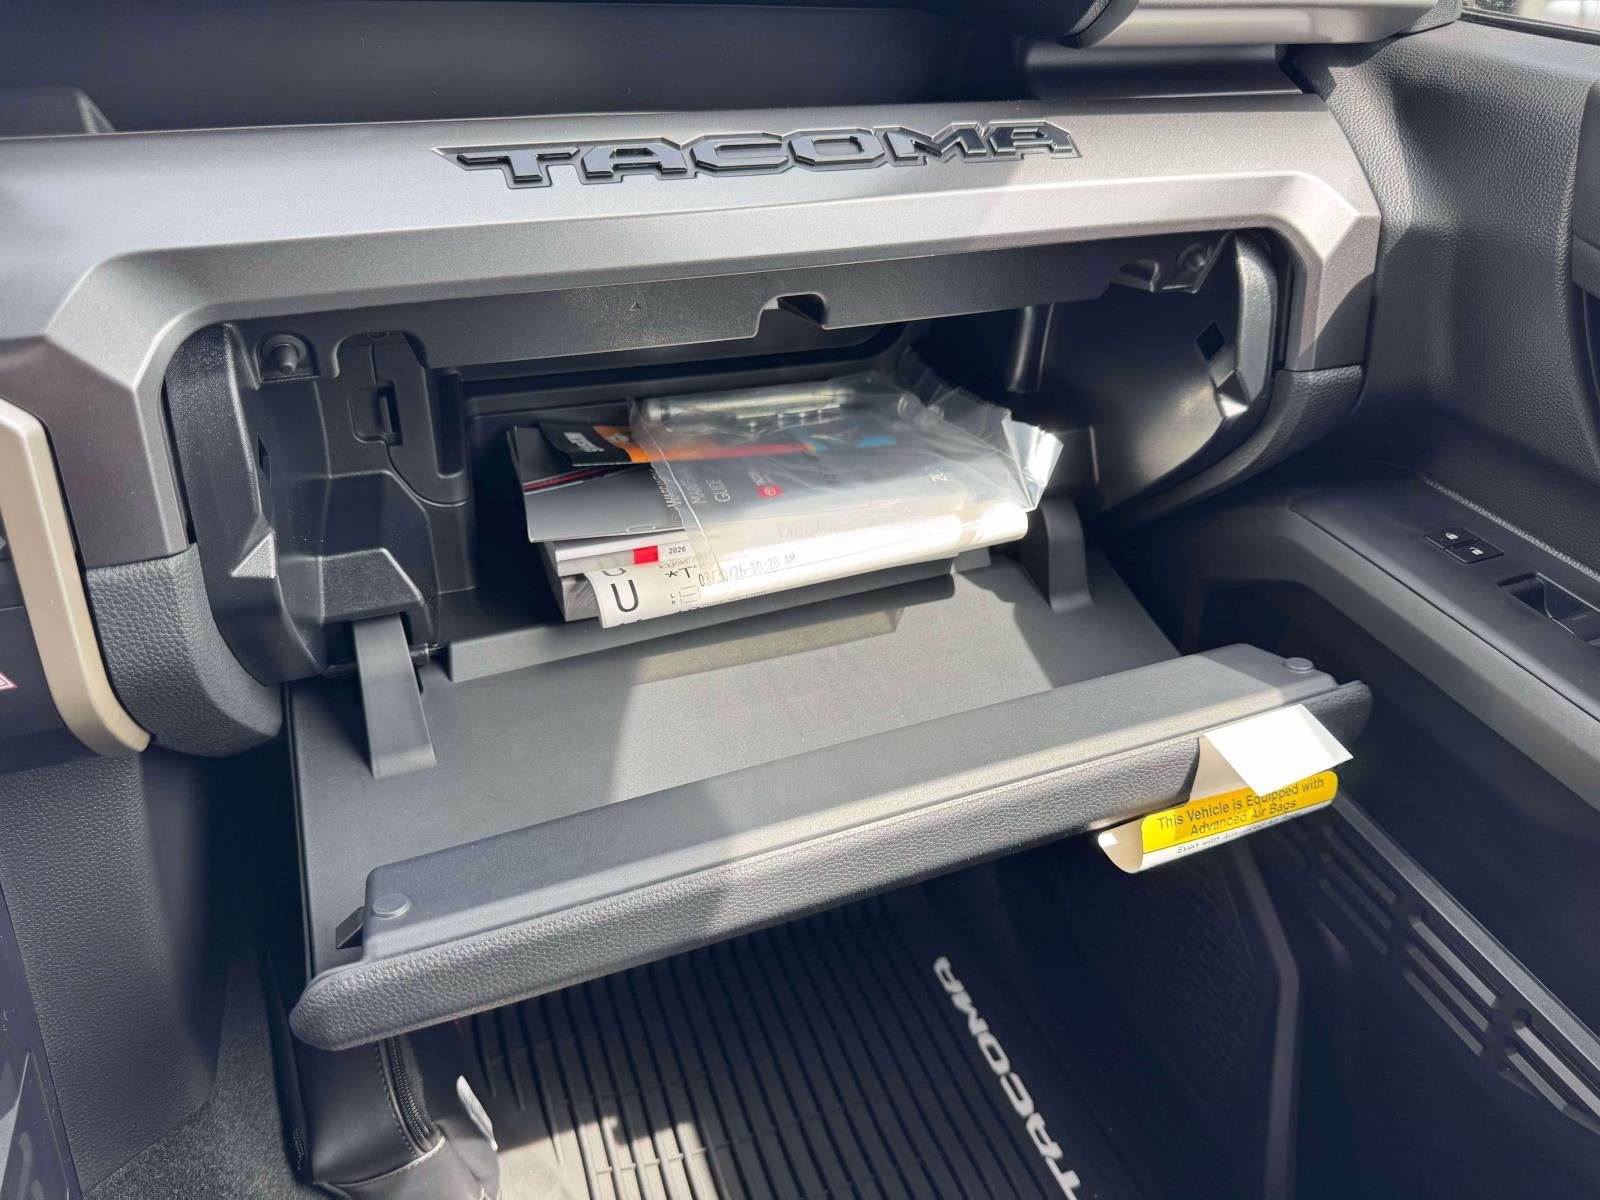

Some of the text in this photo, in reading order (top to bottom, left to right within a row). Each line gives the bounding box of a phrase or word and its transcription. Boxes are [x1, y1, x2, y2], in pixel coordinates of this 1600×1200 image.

[454, 121, 1078, 184] TACOMA
[668, 545, 687, 555] 2026
[611, 579, 639, 613] U
[1157, 777, 1325, 831] This Vehicle is Equipped with
[1190, 813, 1247, 836] Advanced
[1250, 806, 1265, 820] Air
[1270, 798, 1297, 813] Bags
[933, 956, 1081, 1200] TACOMA
